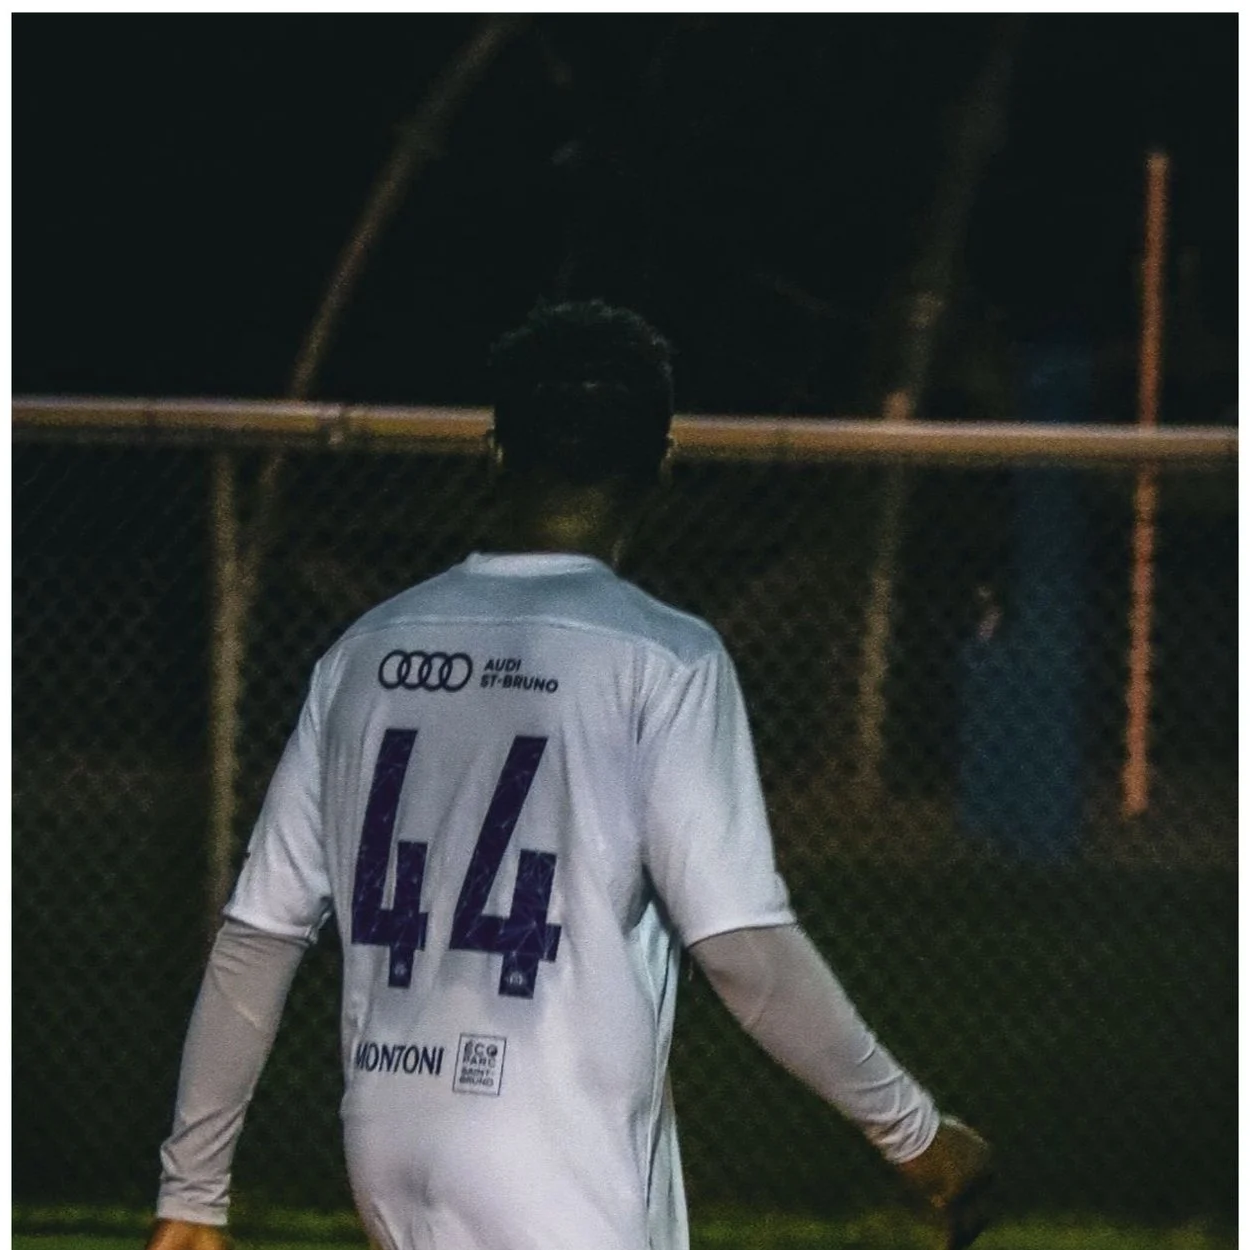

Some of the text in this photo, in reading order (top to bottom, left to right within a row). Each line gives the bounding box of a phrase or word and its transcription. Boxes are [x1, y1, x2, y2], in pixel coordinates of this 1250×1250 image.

[484, 657, 522, 672] AUDI
[480, 674, 559, 694] ST-BRUNO
[350, 729, 562, 999] 44
[354, 1041, 446, 1076] MONTONI
